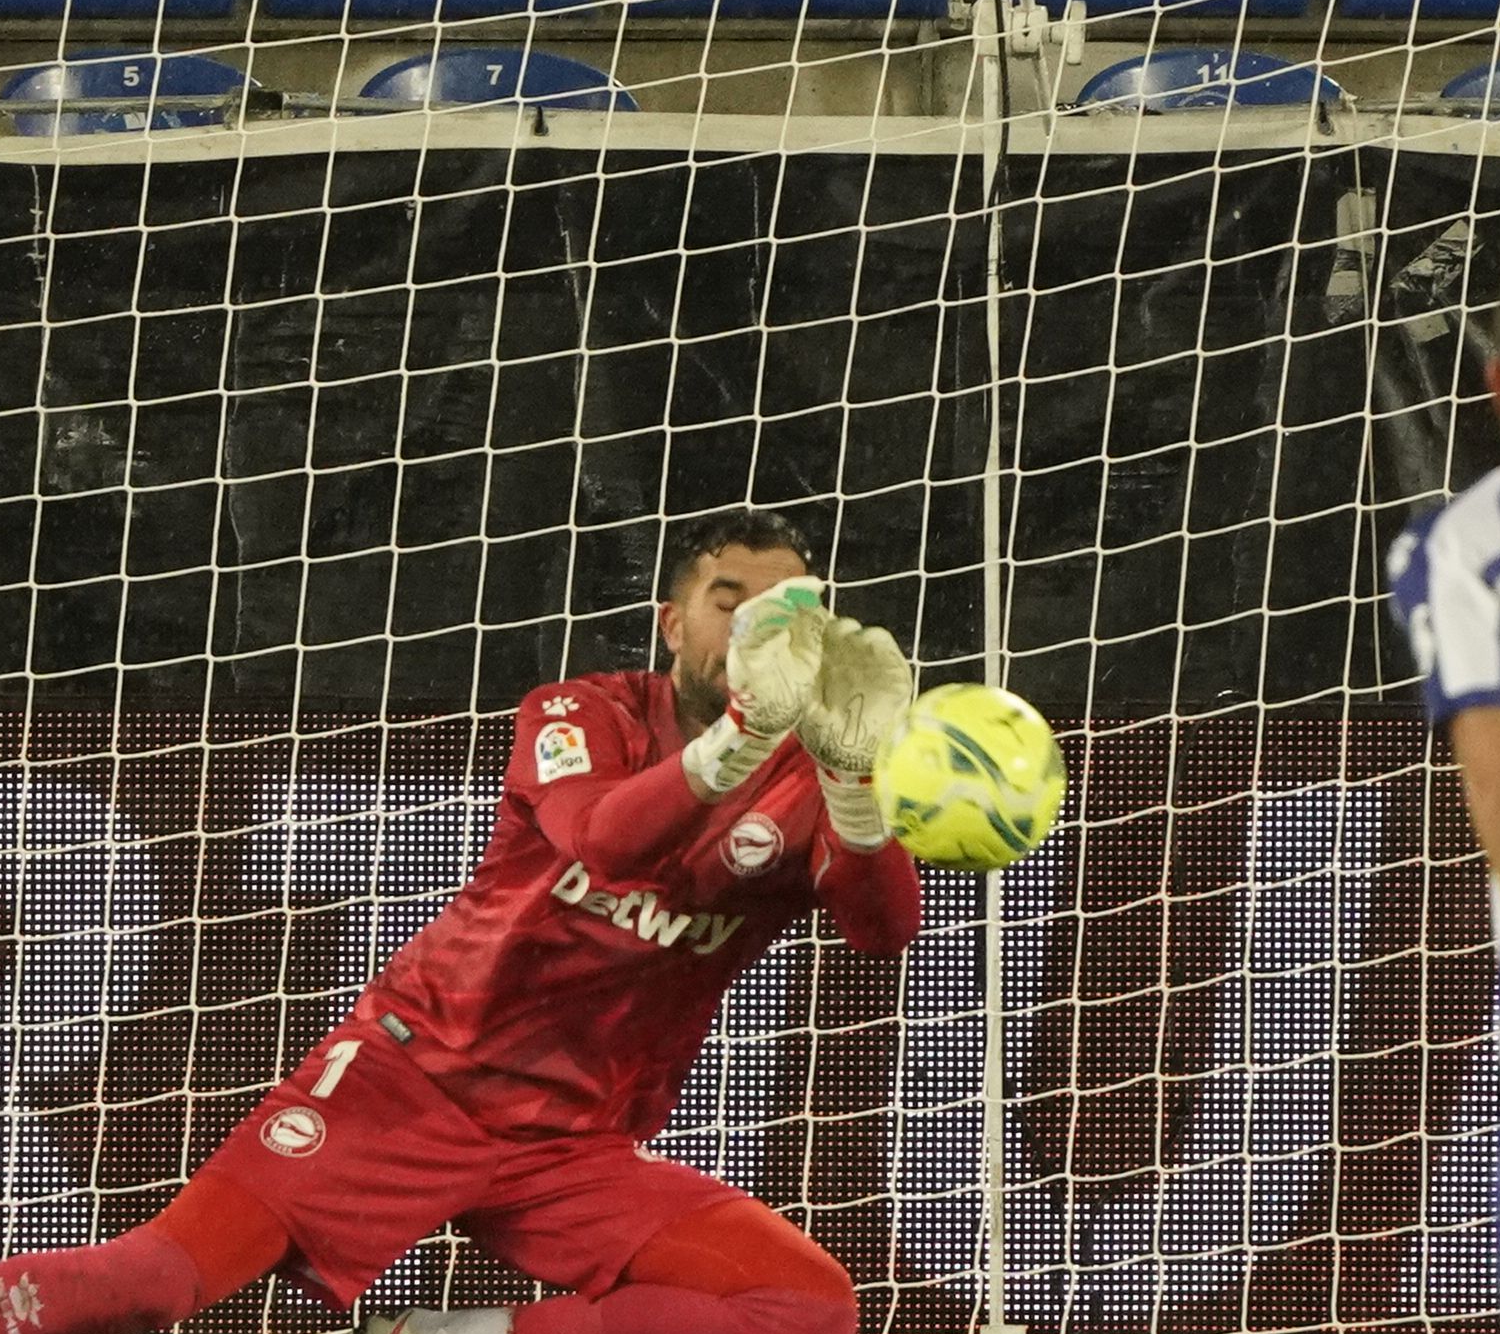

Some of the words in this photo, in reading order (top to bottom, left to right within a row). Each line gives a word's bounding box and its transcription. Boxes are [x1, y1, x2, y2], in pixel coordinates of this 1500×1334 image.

[123, 66, 140, 87] 5
[486, 65, 504, 86] 7
[1197, 64, 1229, 86] 11
[551, 860, 746, 955] betway
[310, 1040, 361, 1099] 1
